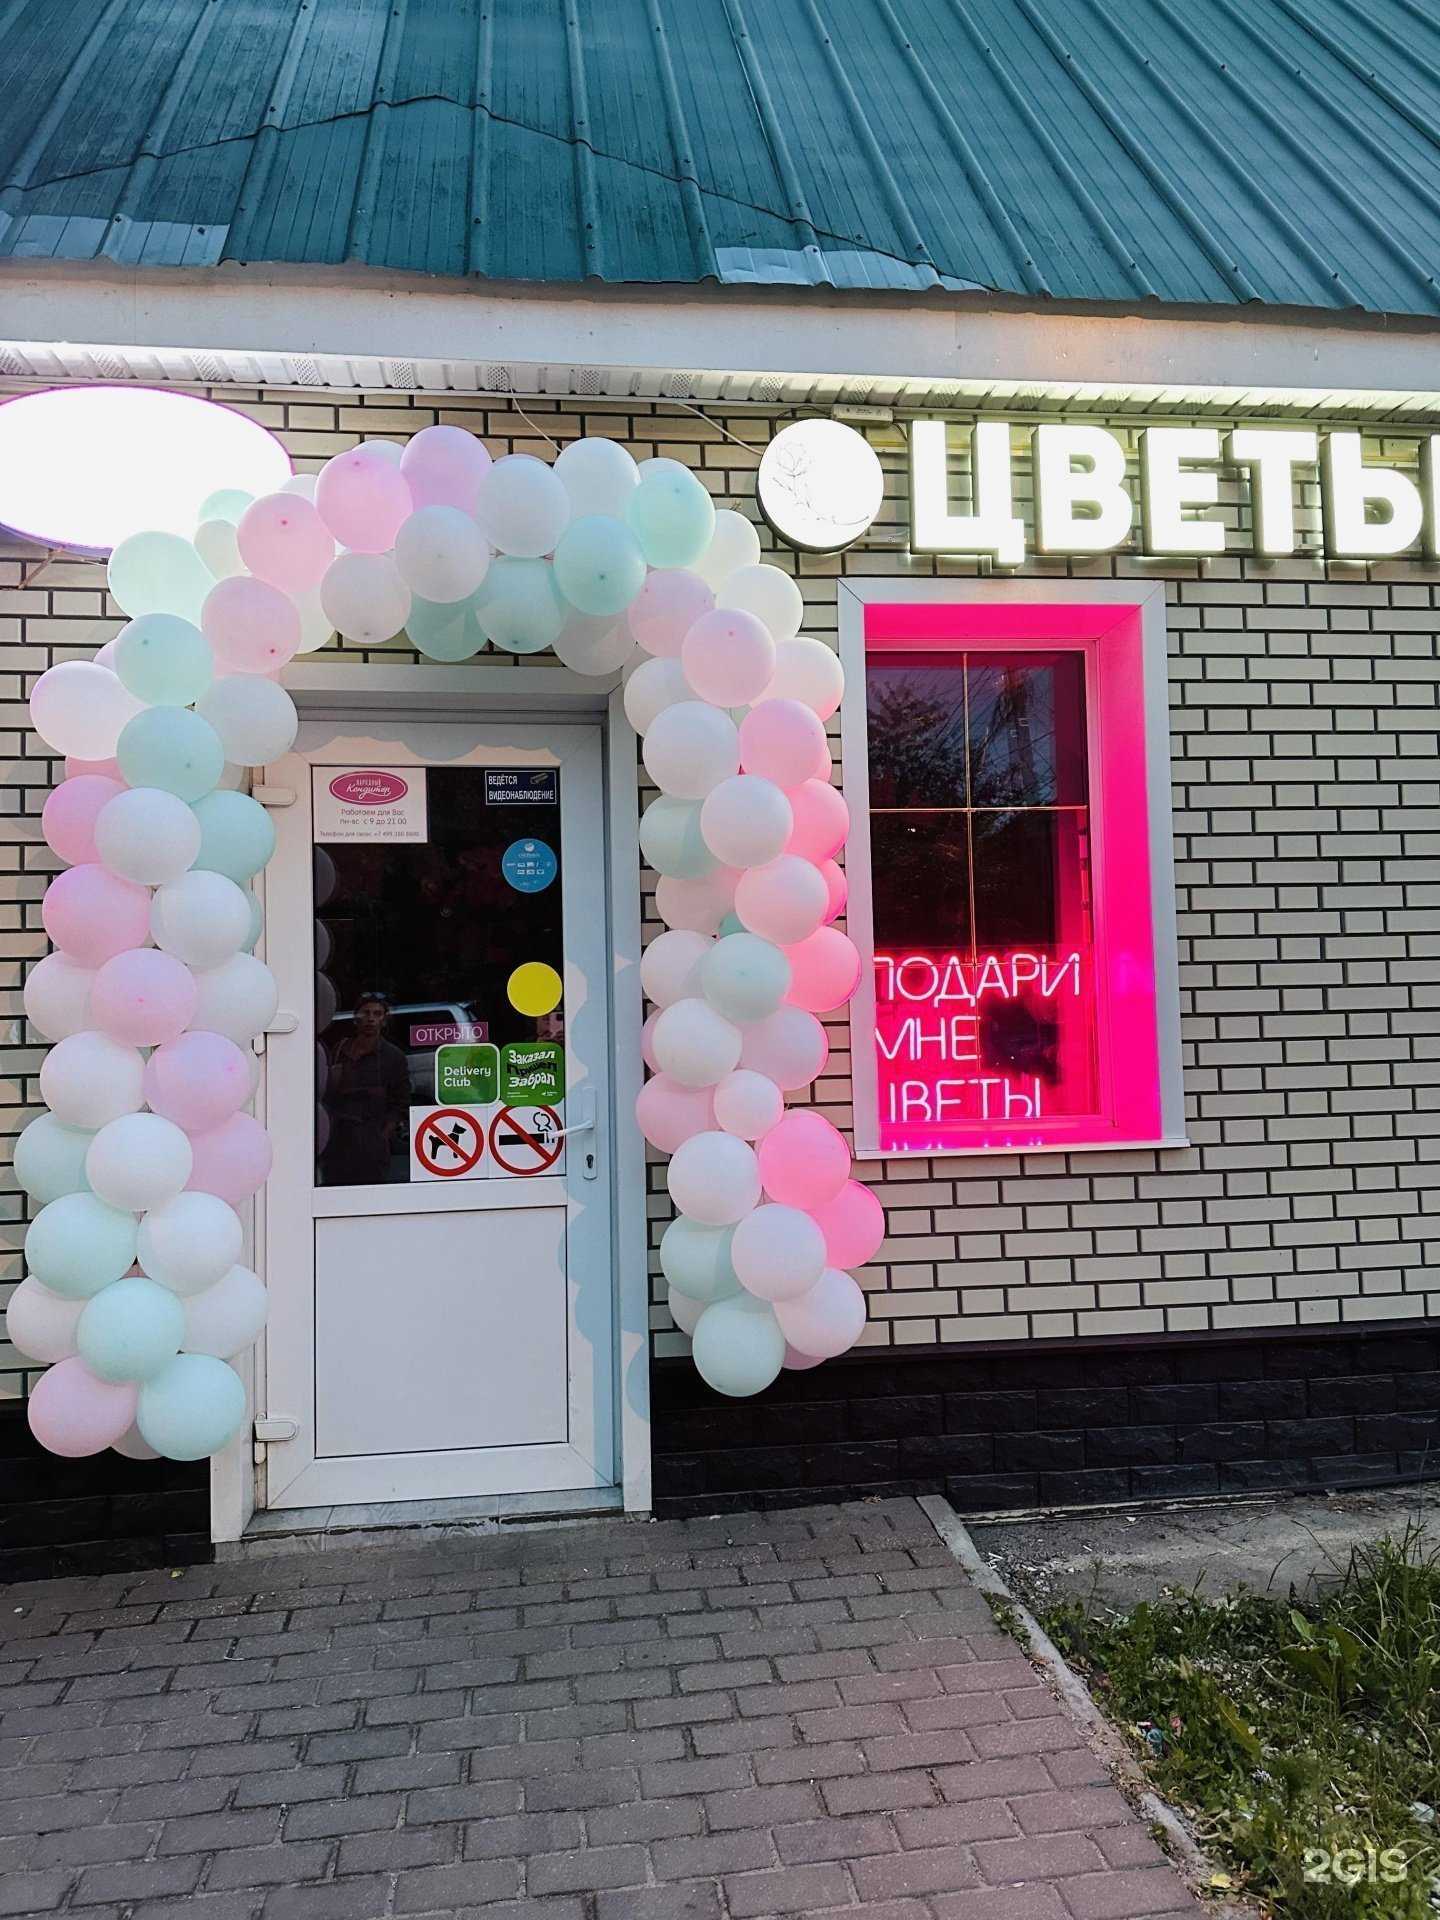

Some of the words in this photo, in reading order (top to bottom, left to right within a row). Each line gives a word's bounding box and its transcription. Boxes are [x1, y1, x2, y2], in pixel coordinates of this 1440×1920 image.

[909, 420, 1440, 568] ЦВЕТЫ
[488, 790, 554, 801] ВИДЕОНАБЛЮДЕНИЕ
[873, 953, 1080, 1008] ПОДАРИ
[416, 1026, 483, 1042] ОТКРЫТО
[508, 1050, 556, 1065] Заказал
[444, 1066, 491, 1077] Delivery
[443, 1077, 471, 1087] Club
[508, 1072, 555, 1090] Забрал
